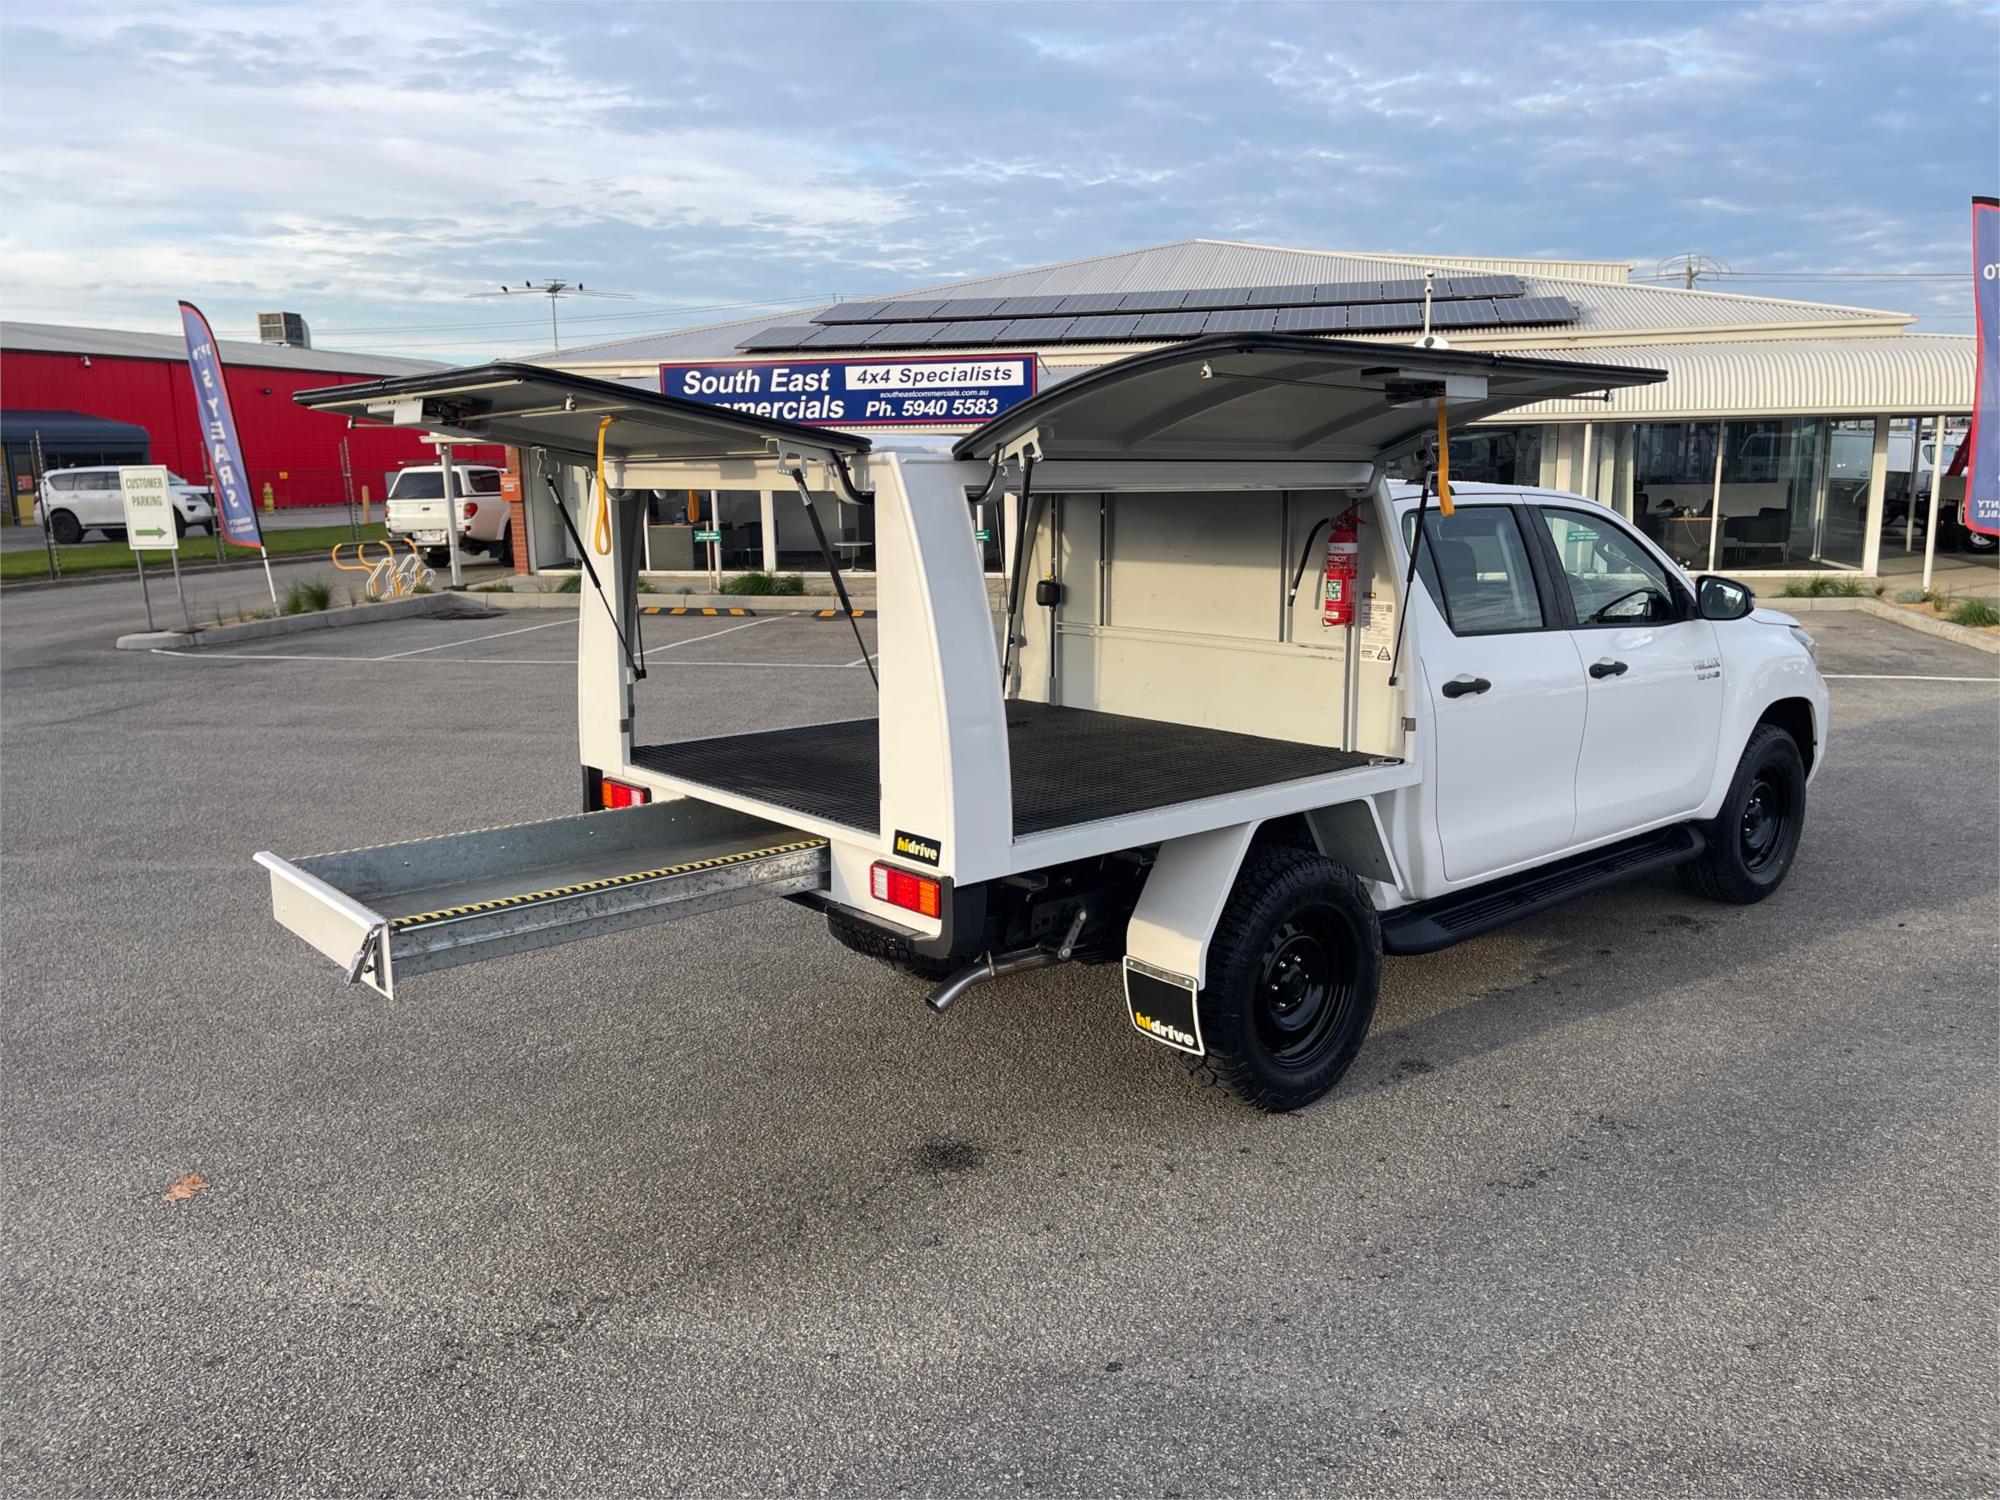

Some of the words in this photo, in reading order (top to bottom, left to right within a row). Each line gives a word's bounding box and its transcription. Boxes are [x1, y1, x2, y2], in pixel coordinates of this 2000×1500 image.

[683, 369, 761, 395] South
[770, 367, 831, 393] East
[857, 368, 891, 384] 4x4
[899, 366, 1013, 386] Specialists
[880, 389, 989, 399] southeastcommercials.com.au
[714, 394, 846, 420] mercials
[865, 400, 896, 417] Ph.
[901, 399, 948, 417] 5940
[952, 398, 999, 416] 5583
[125, 478, 164, 489] CUSTOMER
[131, 495, 163, 507] PARKING
[897, 836, 938, 861] hidrive
[1135, 1011, 1195, 1047] hidrive
